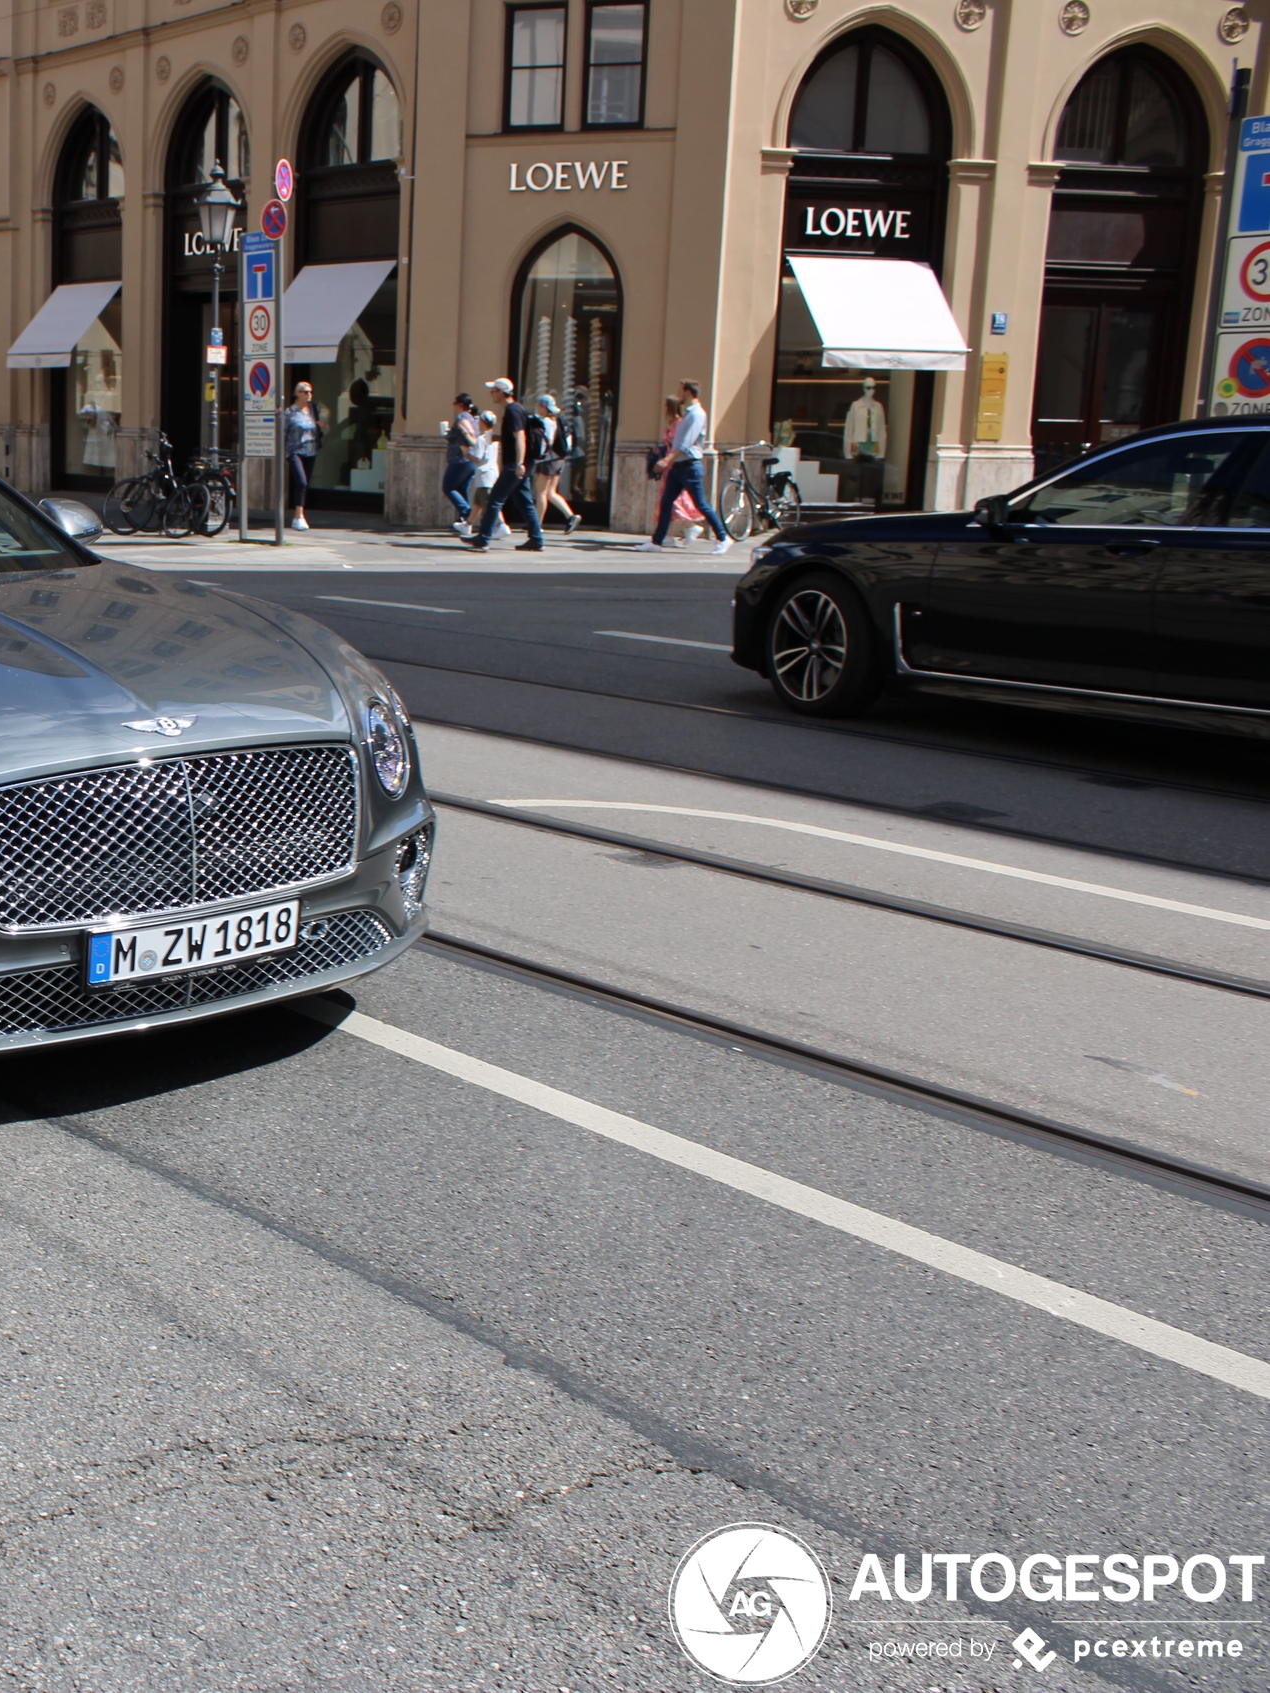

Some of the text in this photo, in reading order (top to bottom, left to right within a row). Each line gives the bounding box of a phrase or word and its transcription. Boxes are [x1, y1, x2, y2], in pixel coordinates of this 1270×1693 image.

[509, 161, 629, 191] LOEWE
[805, 207, 911, 238] LOEWE
[253, 315, 267, 331] 30
[251, 342, 268, 353] ZONE
[113, 907, 292, 975] M ZW 1818
[96, 963, 105, 974] D
